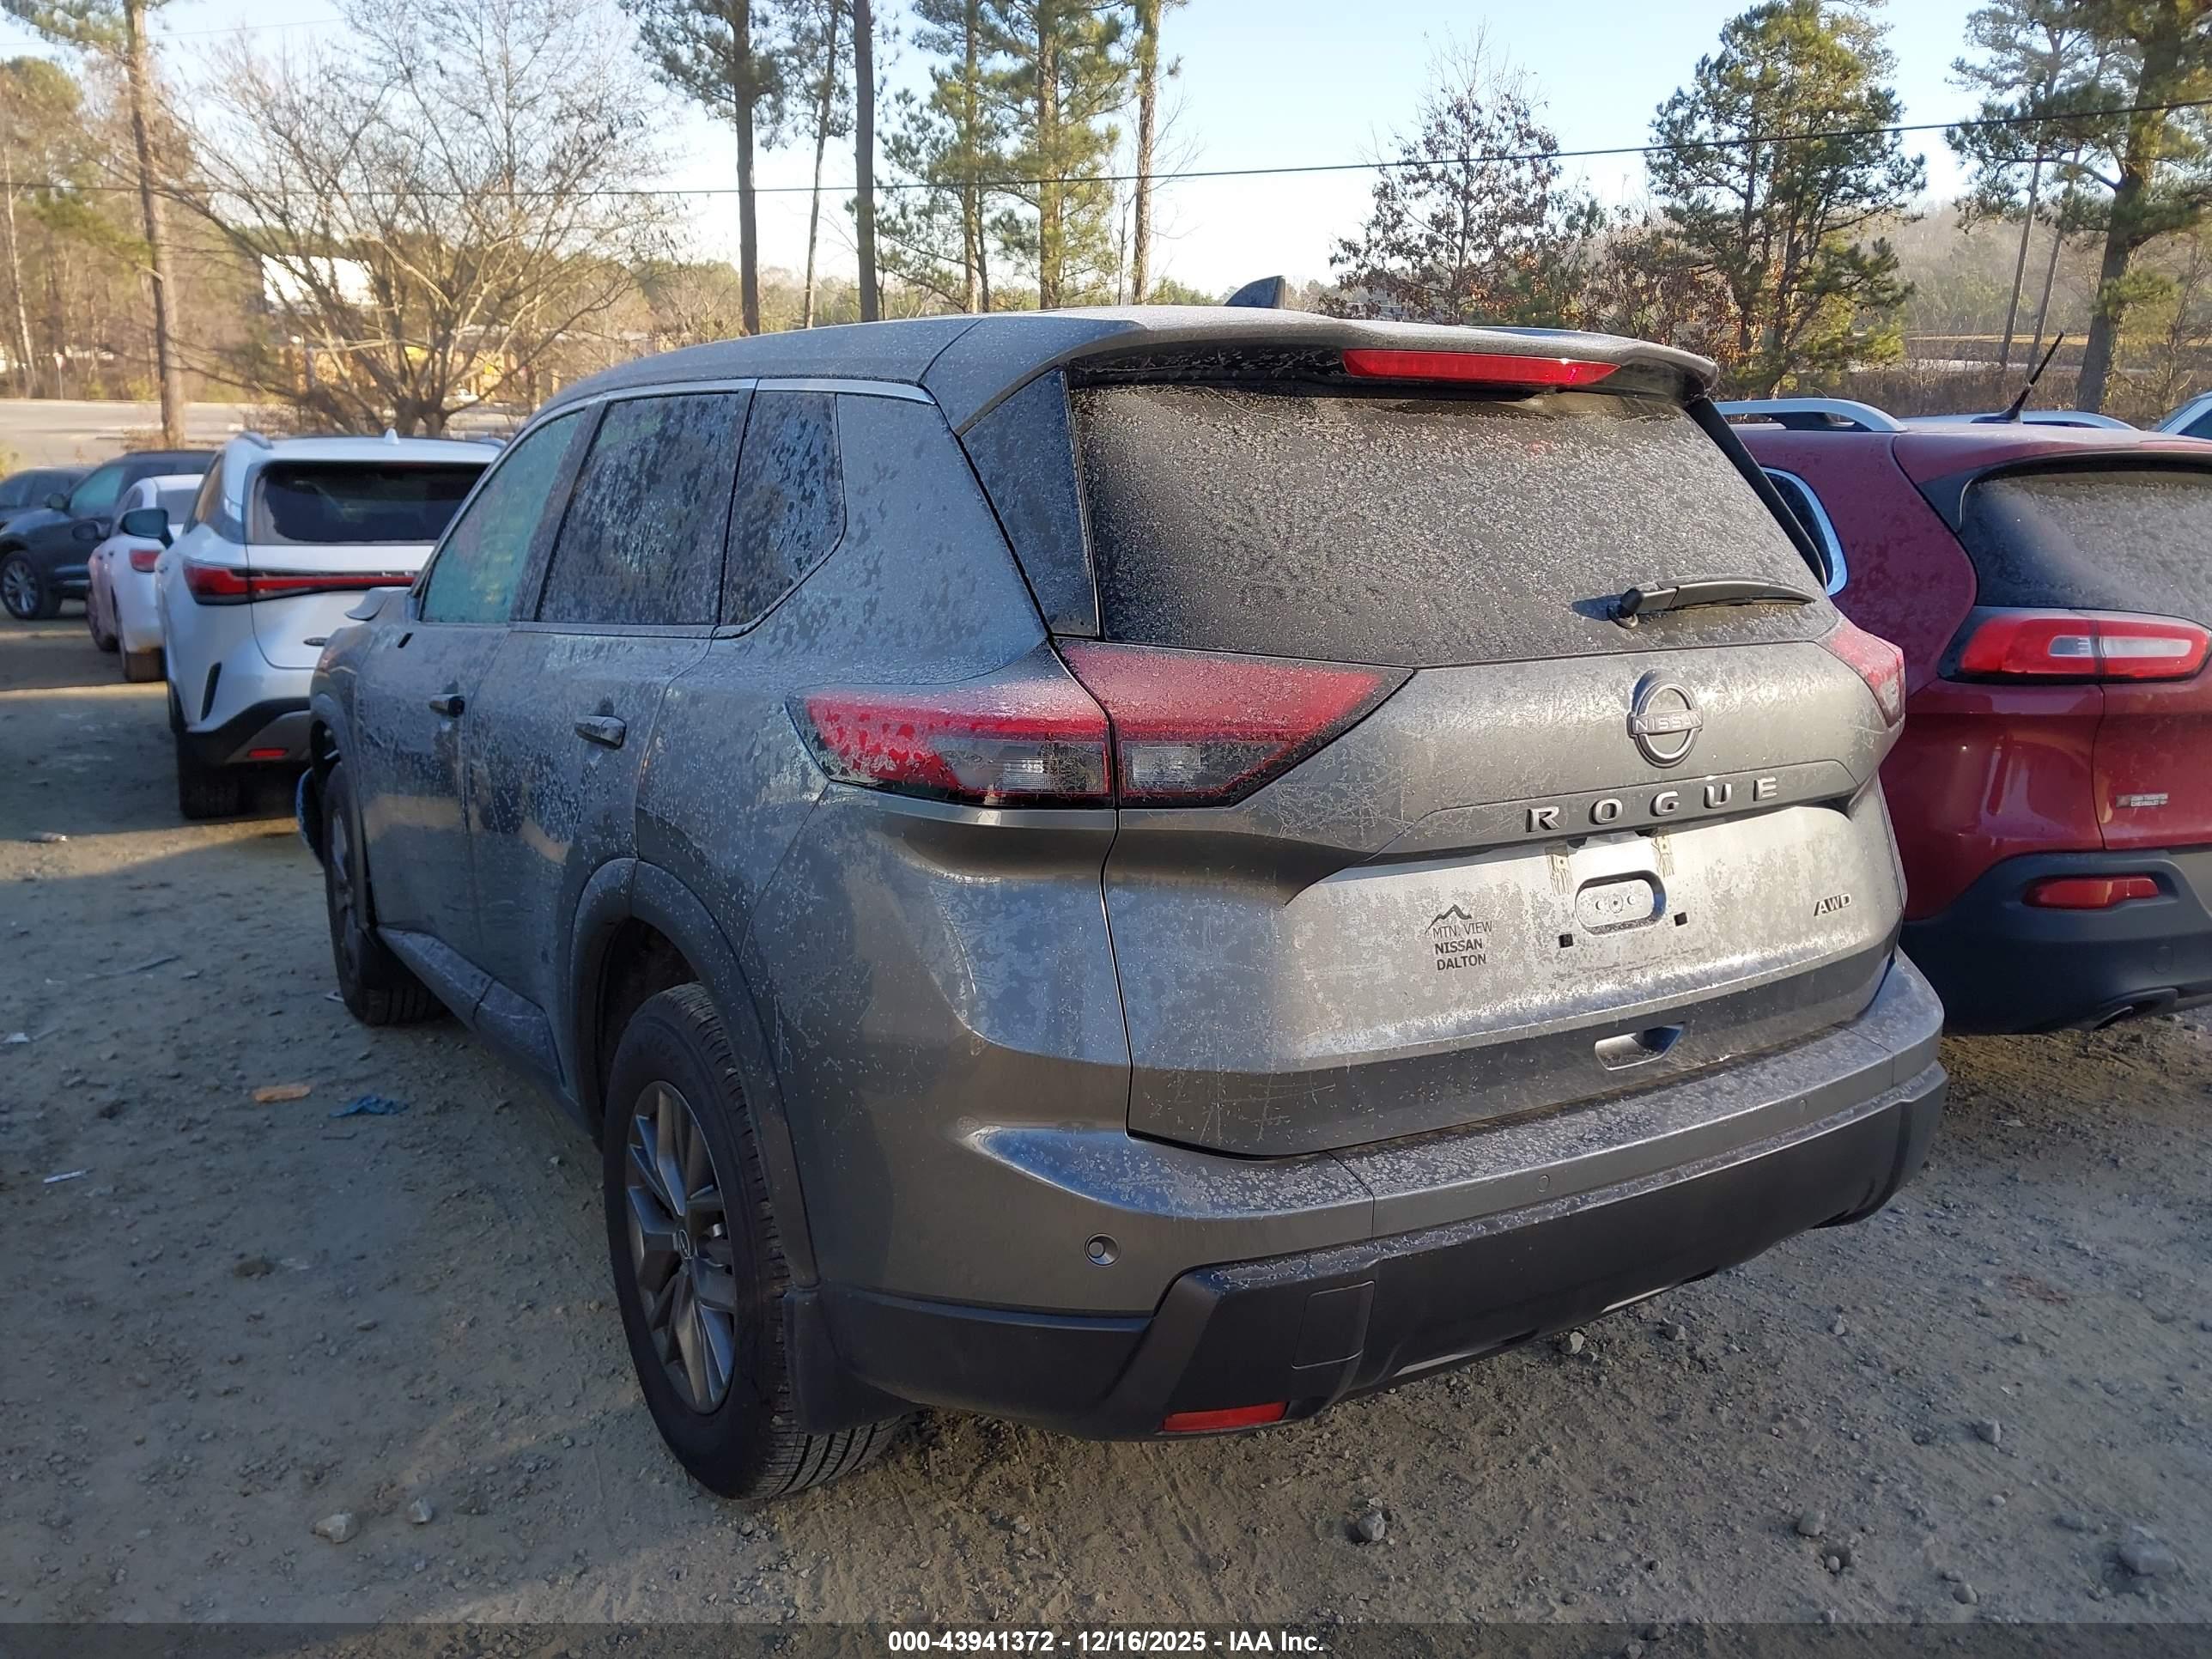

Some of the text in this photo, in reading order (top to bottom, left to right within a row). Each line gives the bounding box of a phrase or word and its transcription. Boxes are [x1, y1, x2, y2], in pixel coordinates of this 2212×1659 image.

[1635, 713, 1703, 732] NISSAN
[1526, 776, 1778, 833] ROGUE
[1814, 893, 1851, 917] AWD
[1432, 921, 1492, 939] MTN. VIEW
[1434, 938, 1483, 955] NISSAN
[1437, 953, 1486, 971] DALTON
